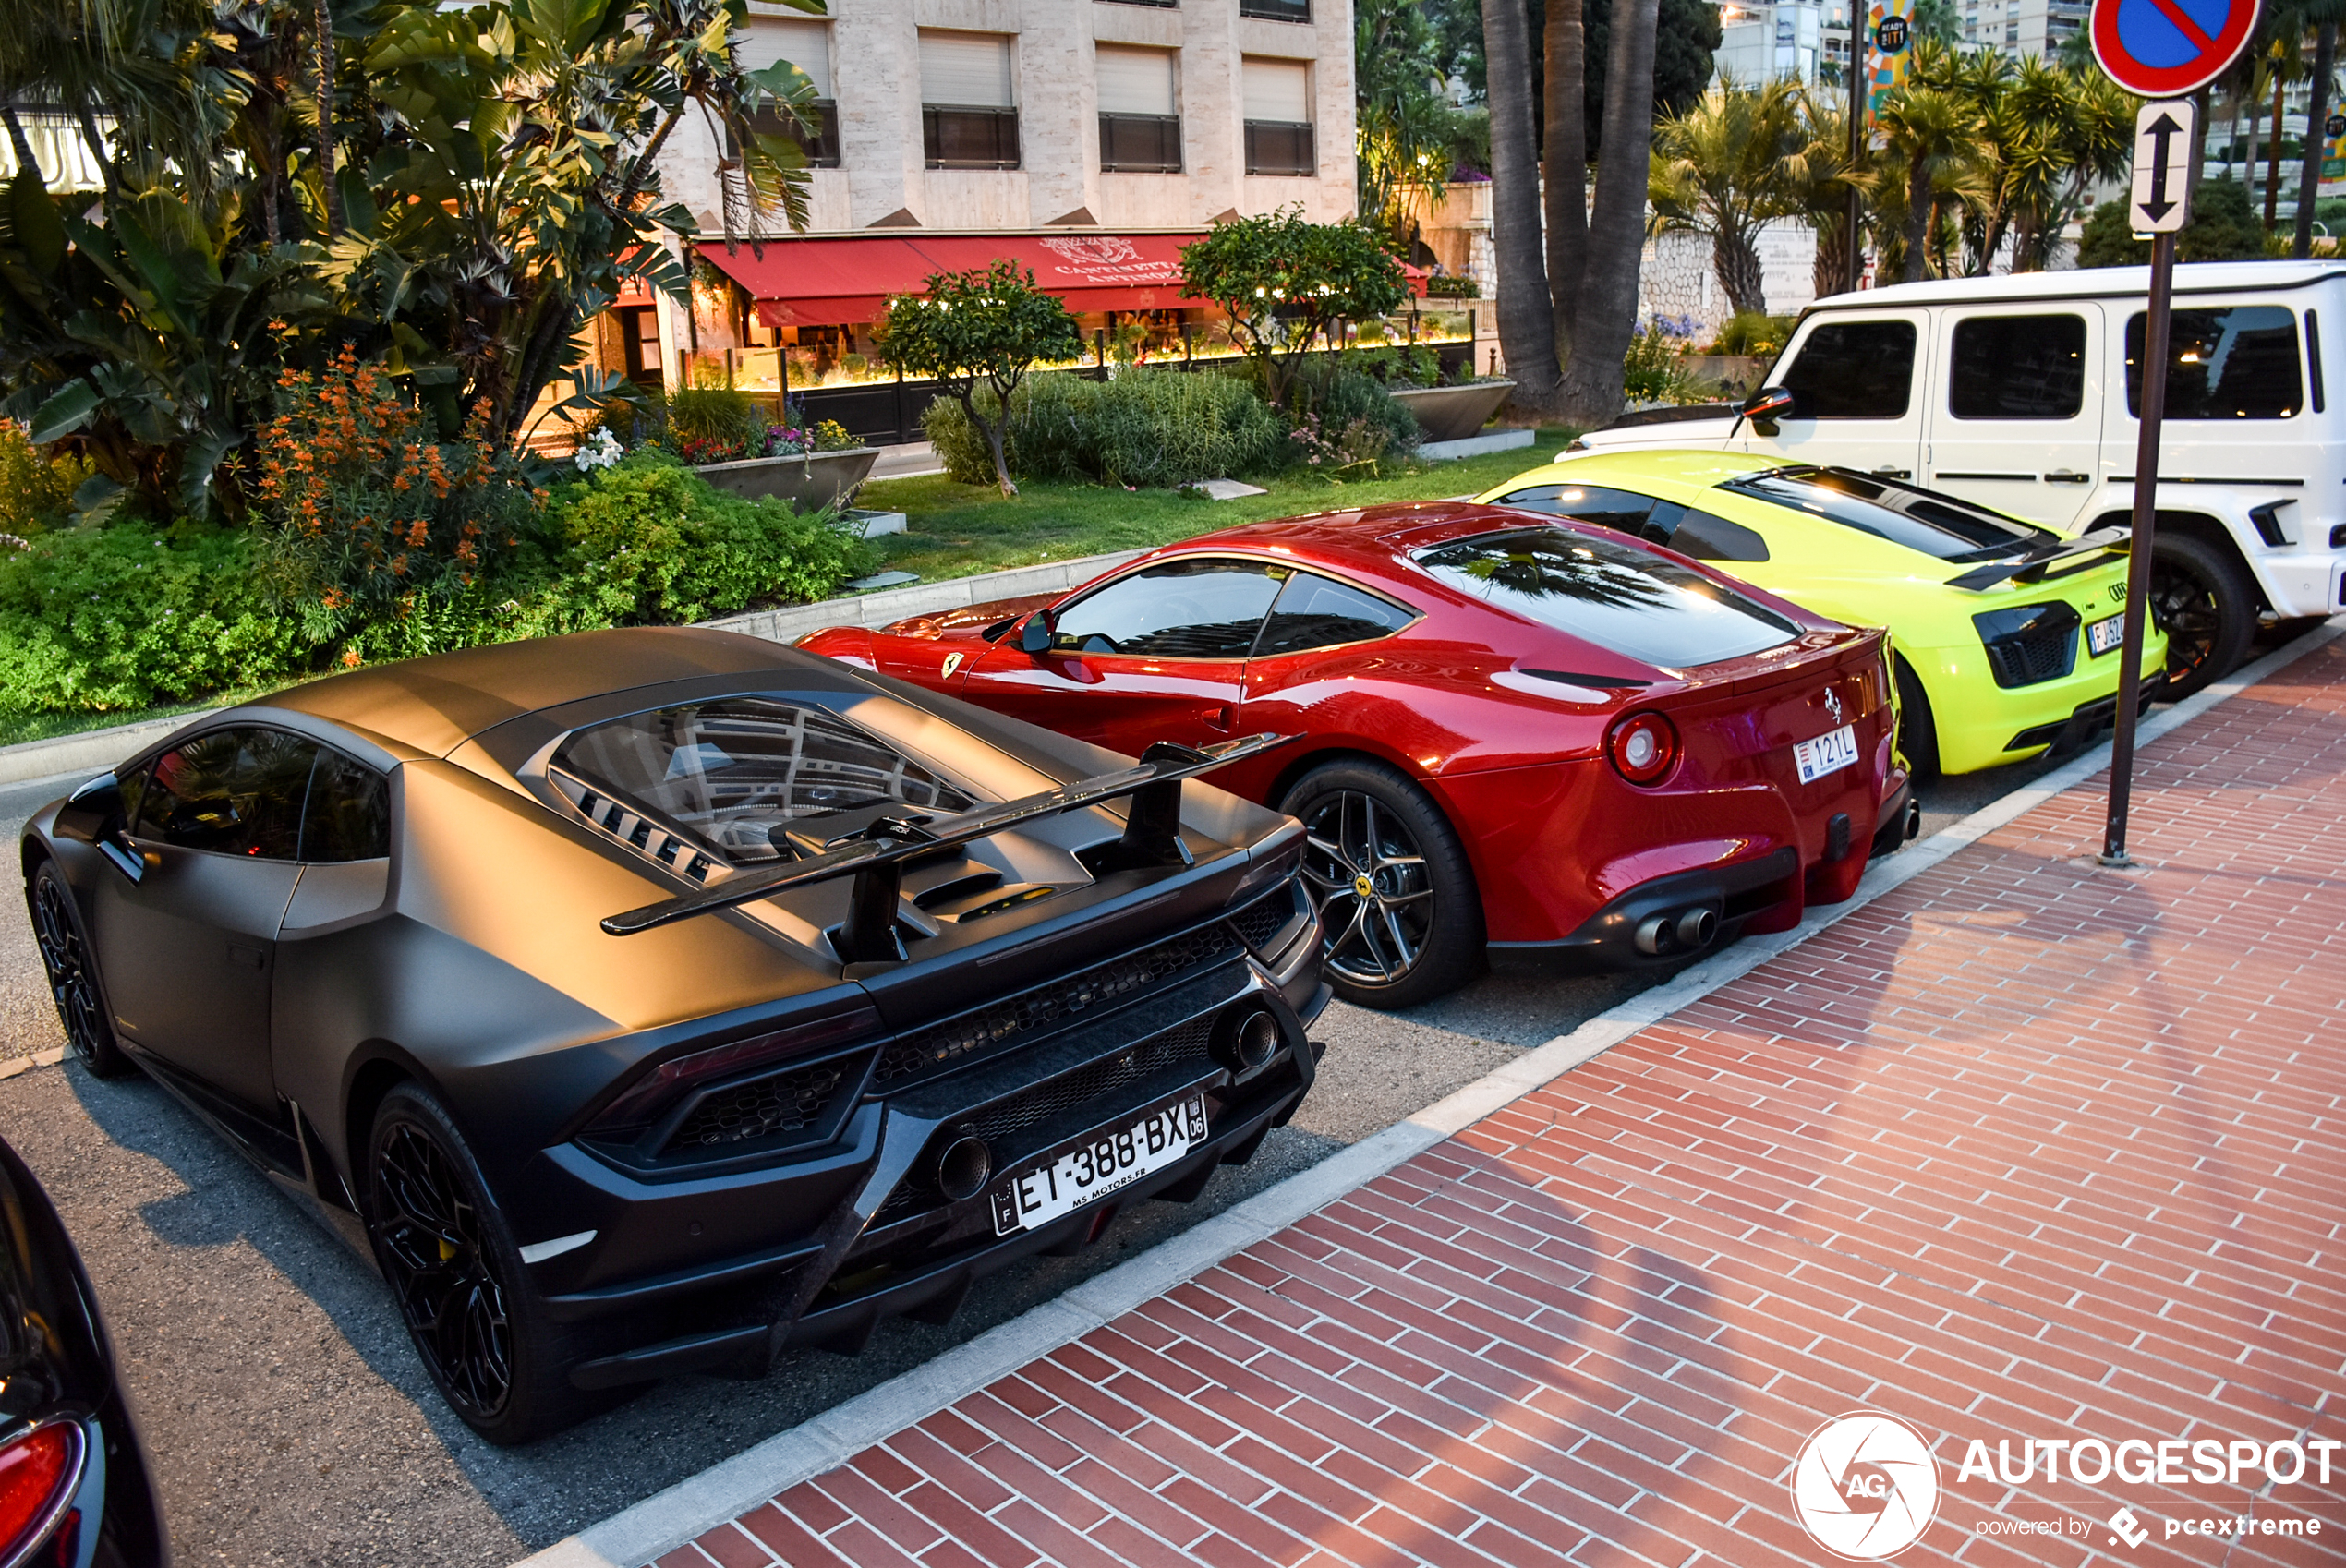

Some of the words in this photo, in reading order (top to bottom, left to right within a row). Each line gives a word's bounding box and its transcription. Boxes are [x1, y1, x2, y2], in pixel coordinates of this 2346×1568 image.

[1882, 22, 1904, 31] READY
[1888, 30, 1904, 44] IT!
[1815, 730, 1853, 766] 121L
[1190, 1116, 1203, 1137] 06
[1017, 1103, 1185, 1215] ET-388-BX
[1072, 1196, 1088, 1208] MS
[1092, 1167, 1146, 1198] MOTORS.FR
[1002, 1208, 1010, 1223] F
